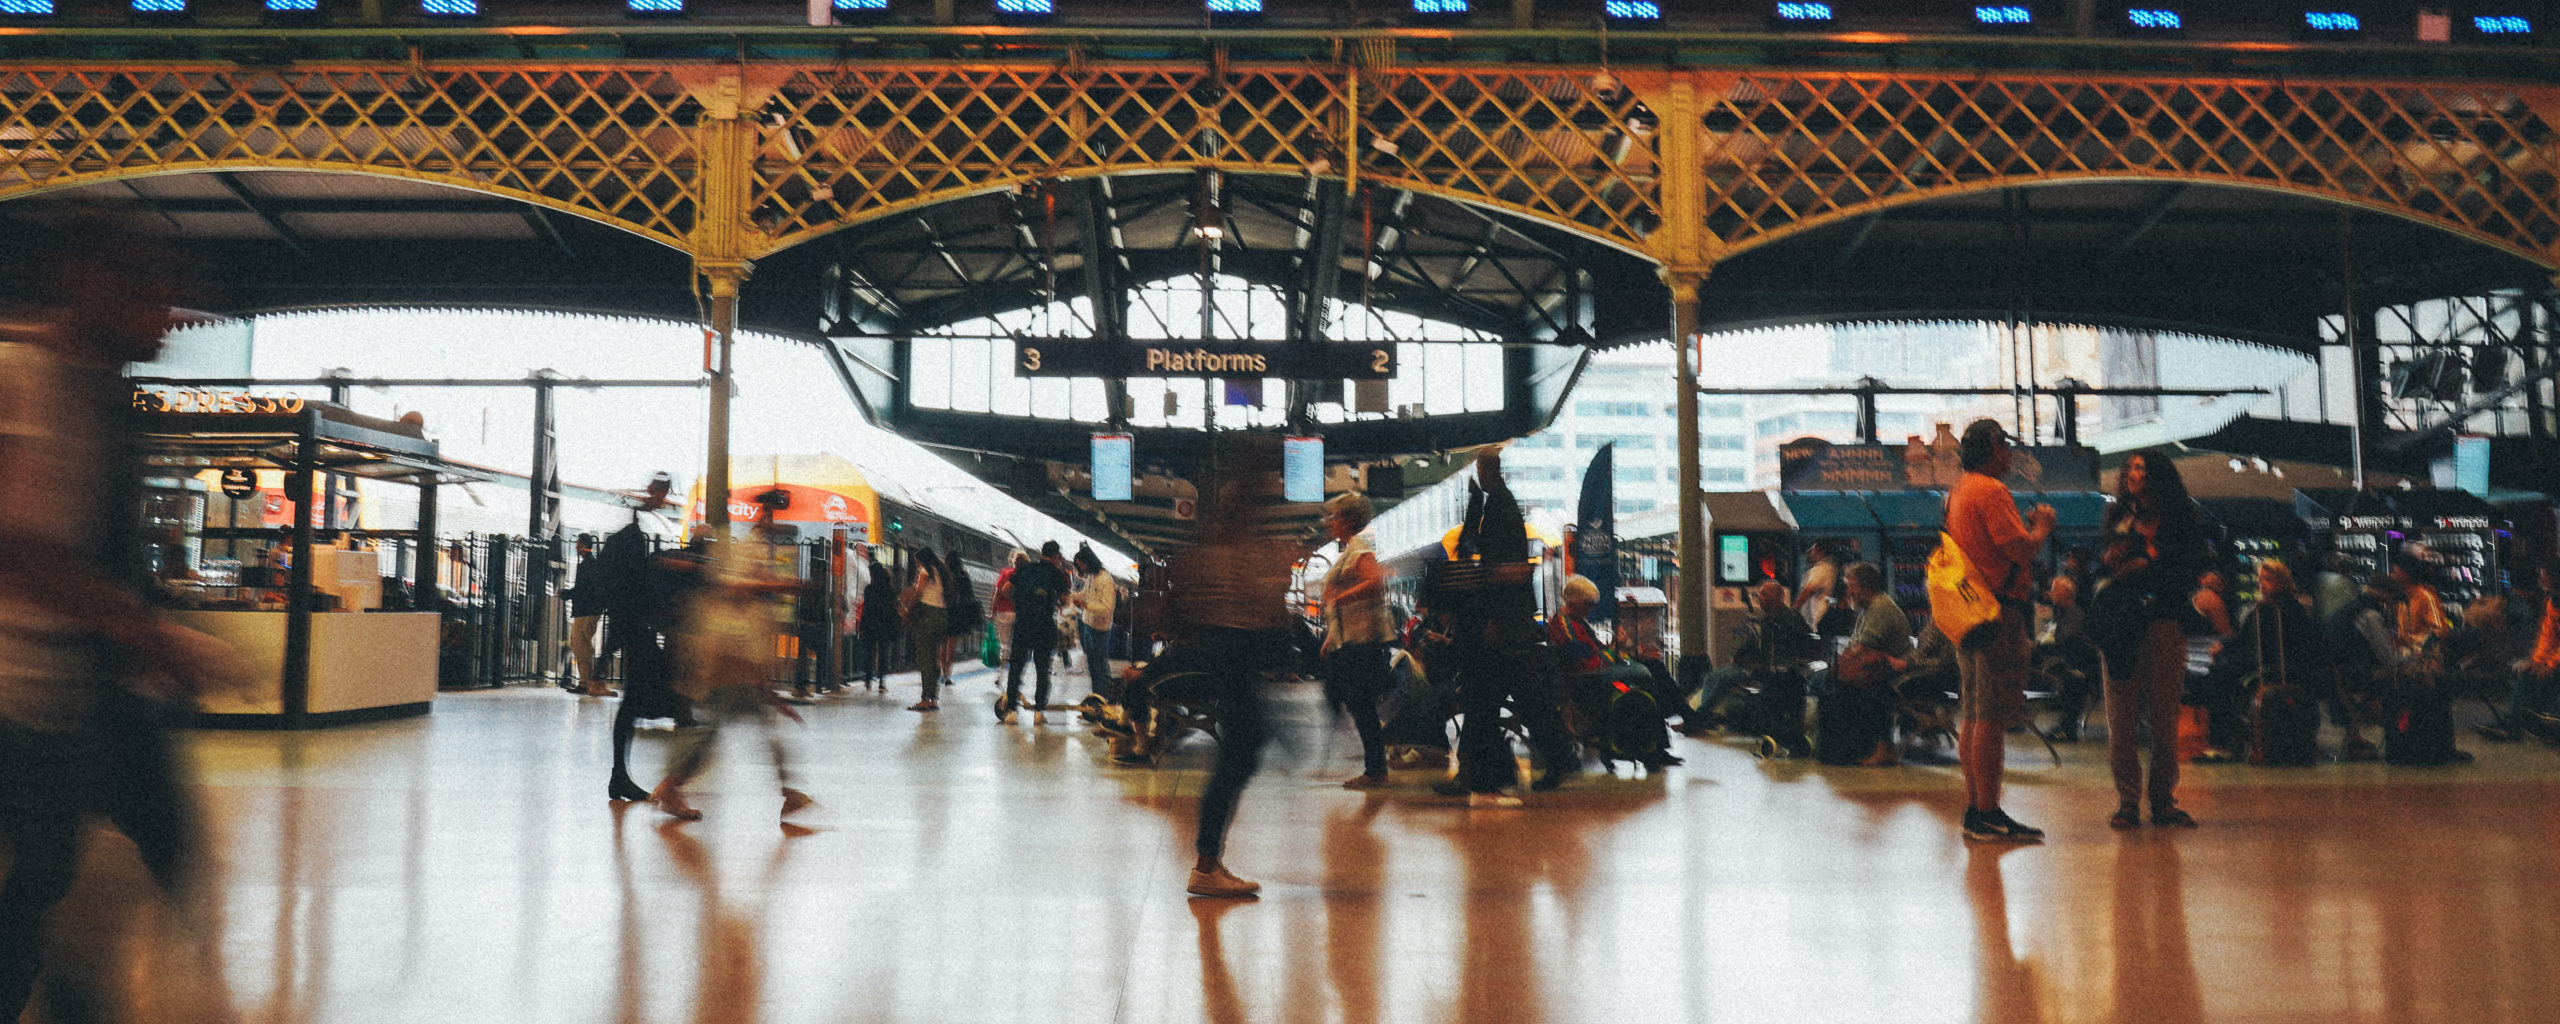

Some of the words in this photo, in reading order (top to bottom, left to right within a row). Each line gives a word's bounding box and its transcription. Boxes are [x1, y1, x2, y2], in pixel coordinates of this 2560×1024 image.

[1023, 347, 1041, 371] 3
[1146, 347, 1267, 372] Platforms
[1371, 349, 1390, 373] 2
[132, 389, 305, 414] ESPRESSO
